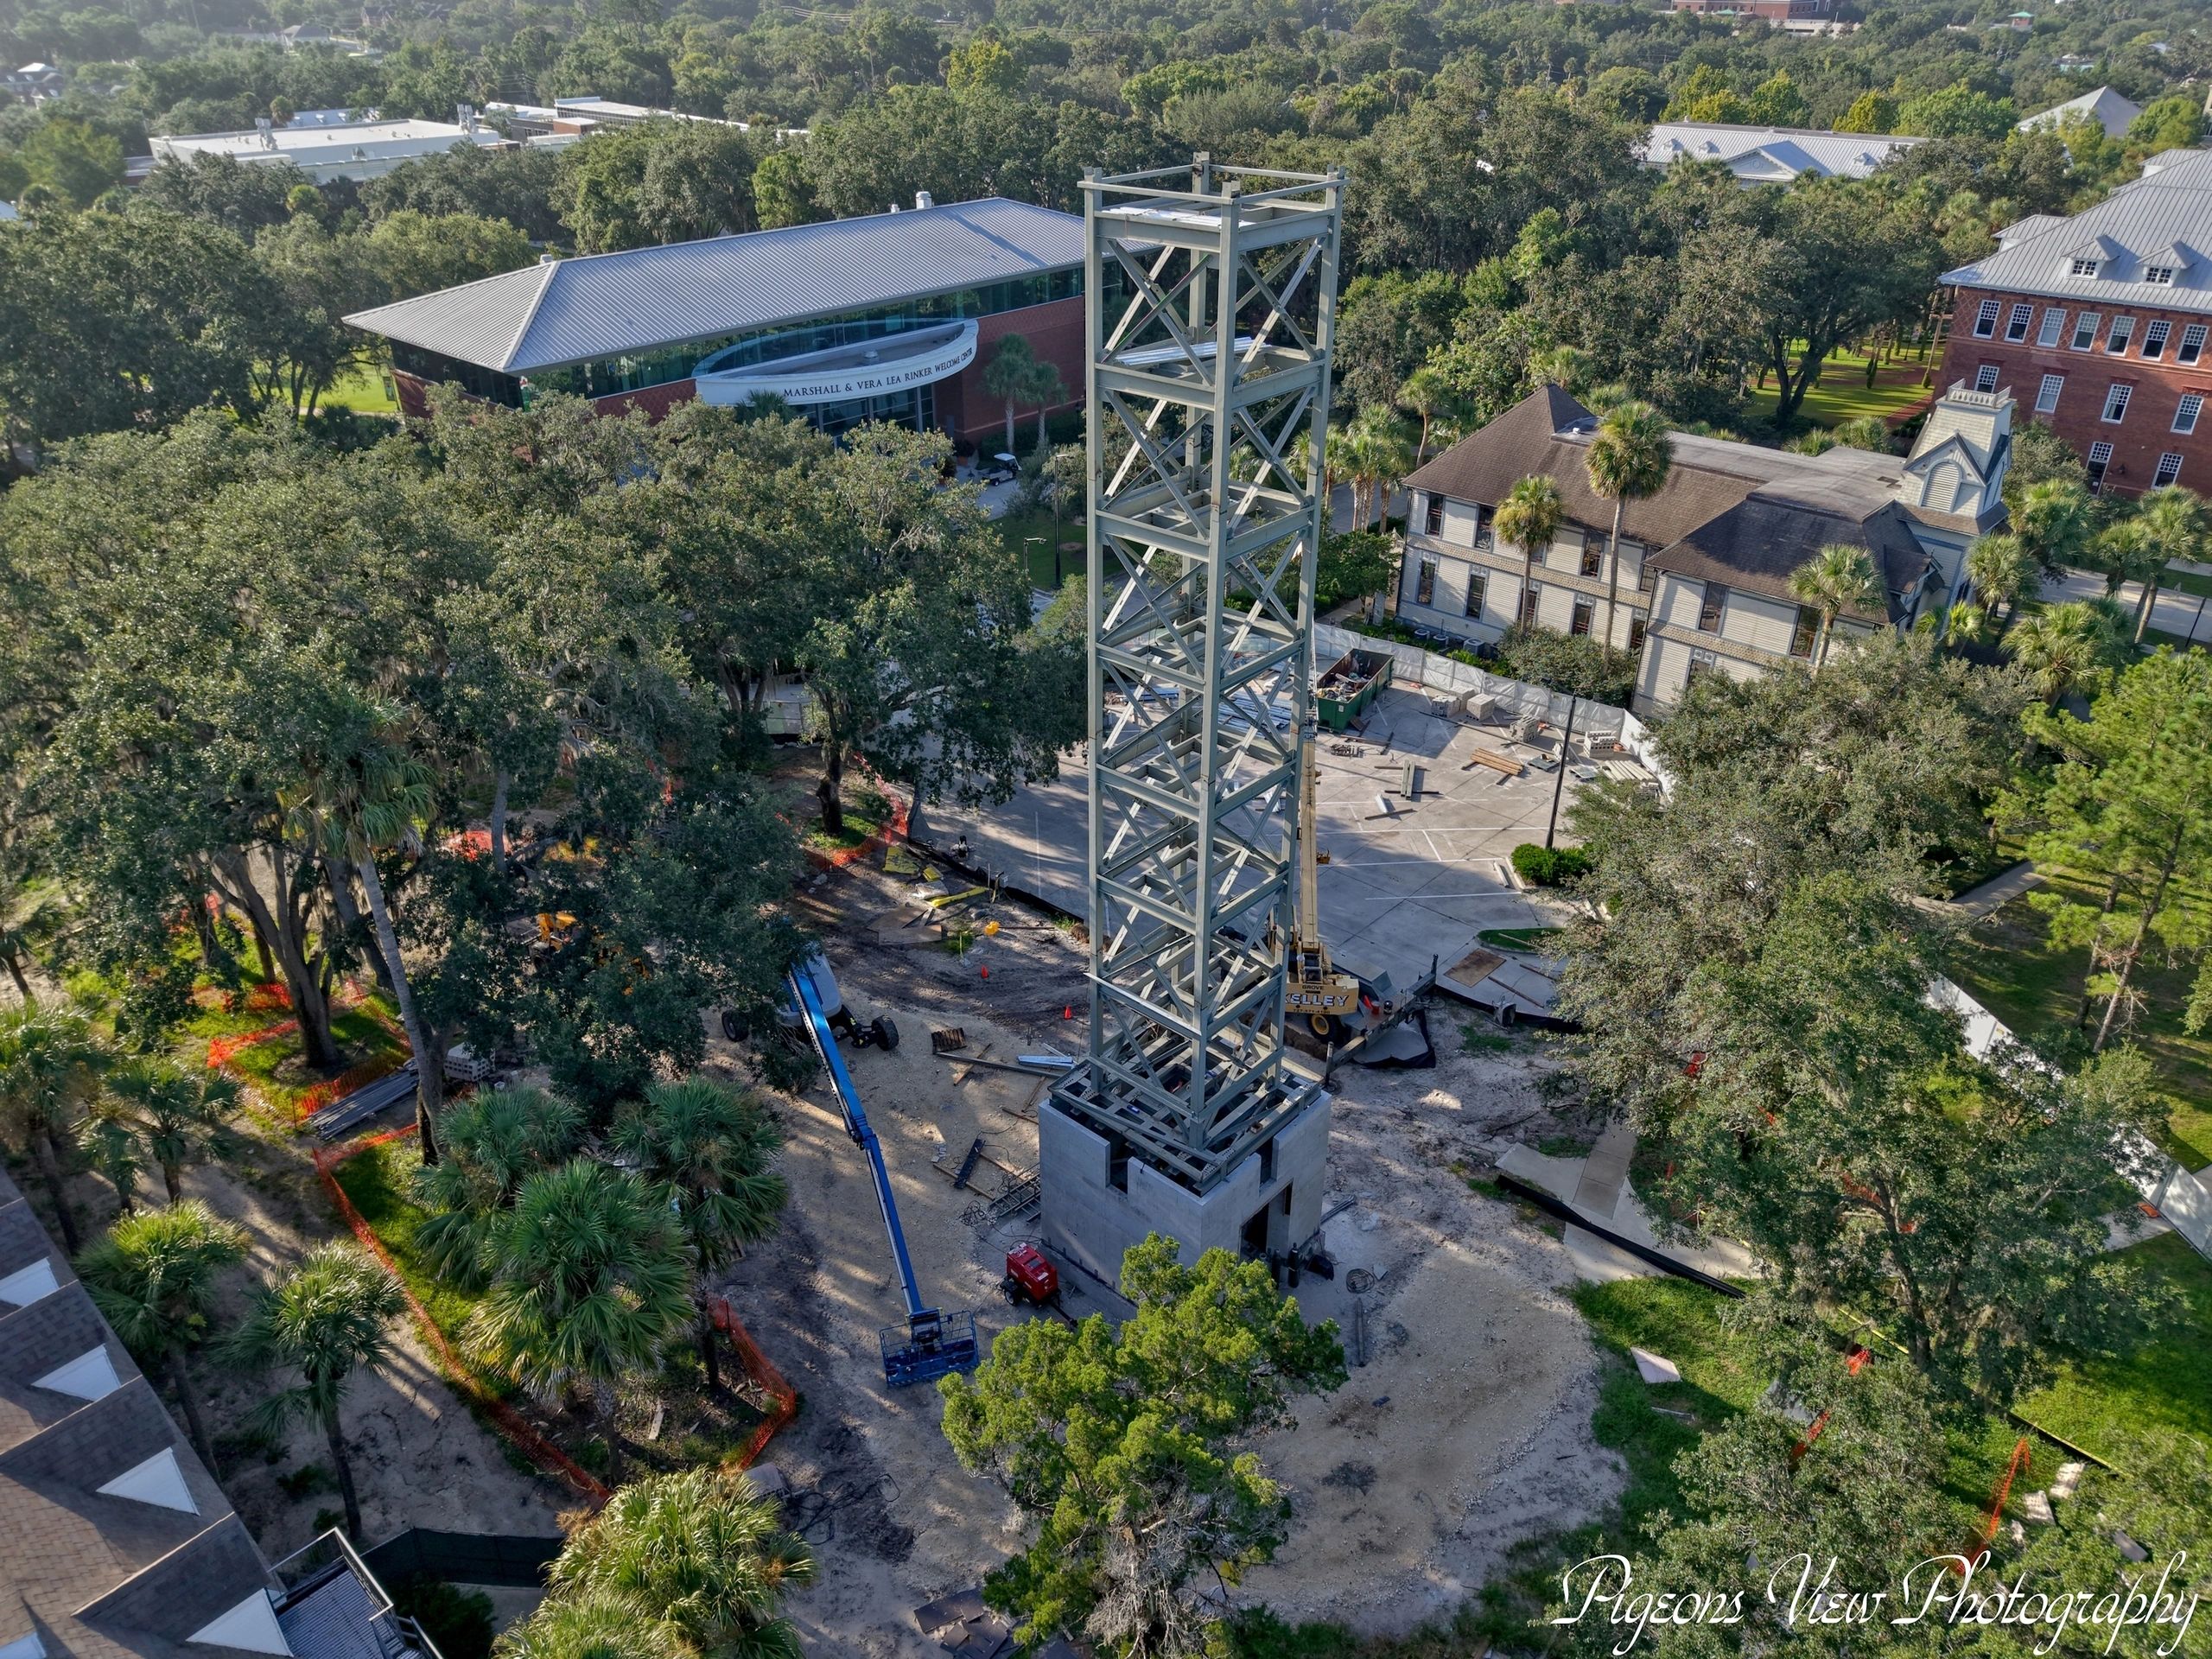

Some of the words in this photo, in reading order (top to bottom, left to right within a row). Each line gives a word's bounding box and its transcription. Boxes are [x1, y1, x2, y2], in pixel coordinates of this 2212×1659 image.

[784, 385, 842, 397] MARSHALL
[845, 383, 853, 391] &
[857, 379, 882, 390] VERA
[887, 376, 901, 385] LEA
[905, 367, 932, 381] RINKER
[934, 356, 960, 372] WELCOME
[961, 347, 973, 361] CENTER
